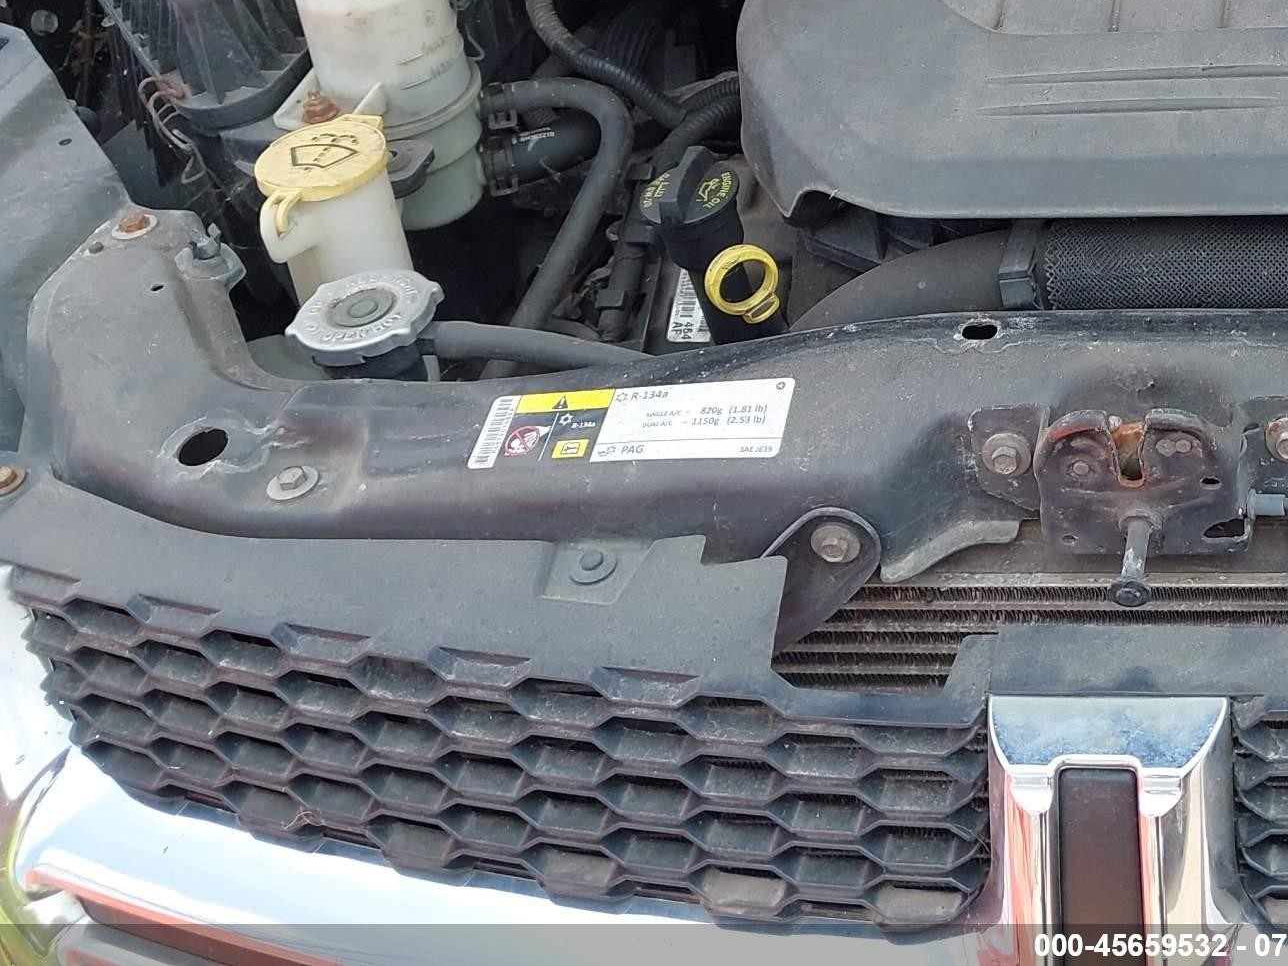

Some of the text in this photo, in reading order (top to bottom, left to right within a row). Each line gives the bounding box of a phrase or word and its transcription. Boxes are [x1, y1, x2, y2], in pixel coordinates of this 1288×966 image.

[702, 172, 733, 209] ENGINE OIL
[630, 390, 669, 402] R-134a
[699, 405, 723, 417] 820g
[728, 404, 752, 415] (1.81
[754, 403, 768, 414] lb)
[691, 417, 720, 428] 1150g
[753, 415, 766, 425] lb)
[620, 444, 645, 454] PAG
